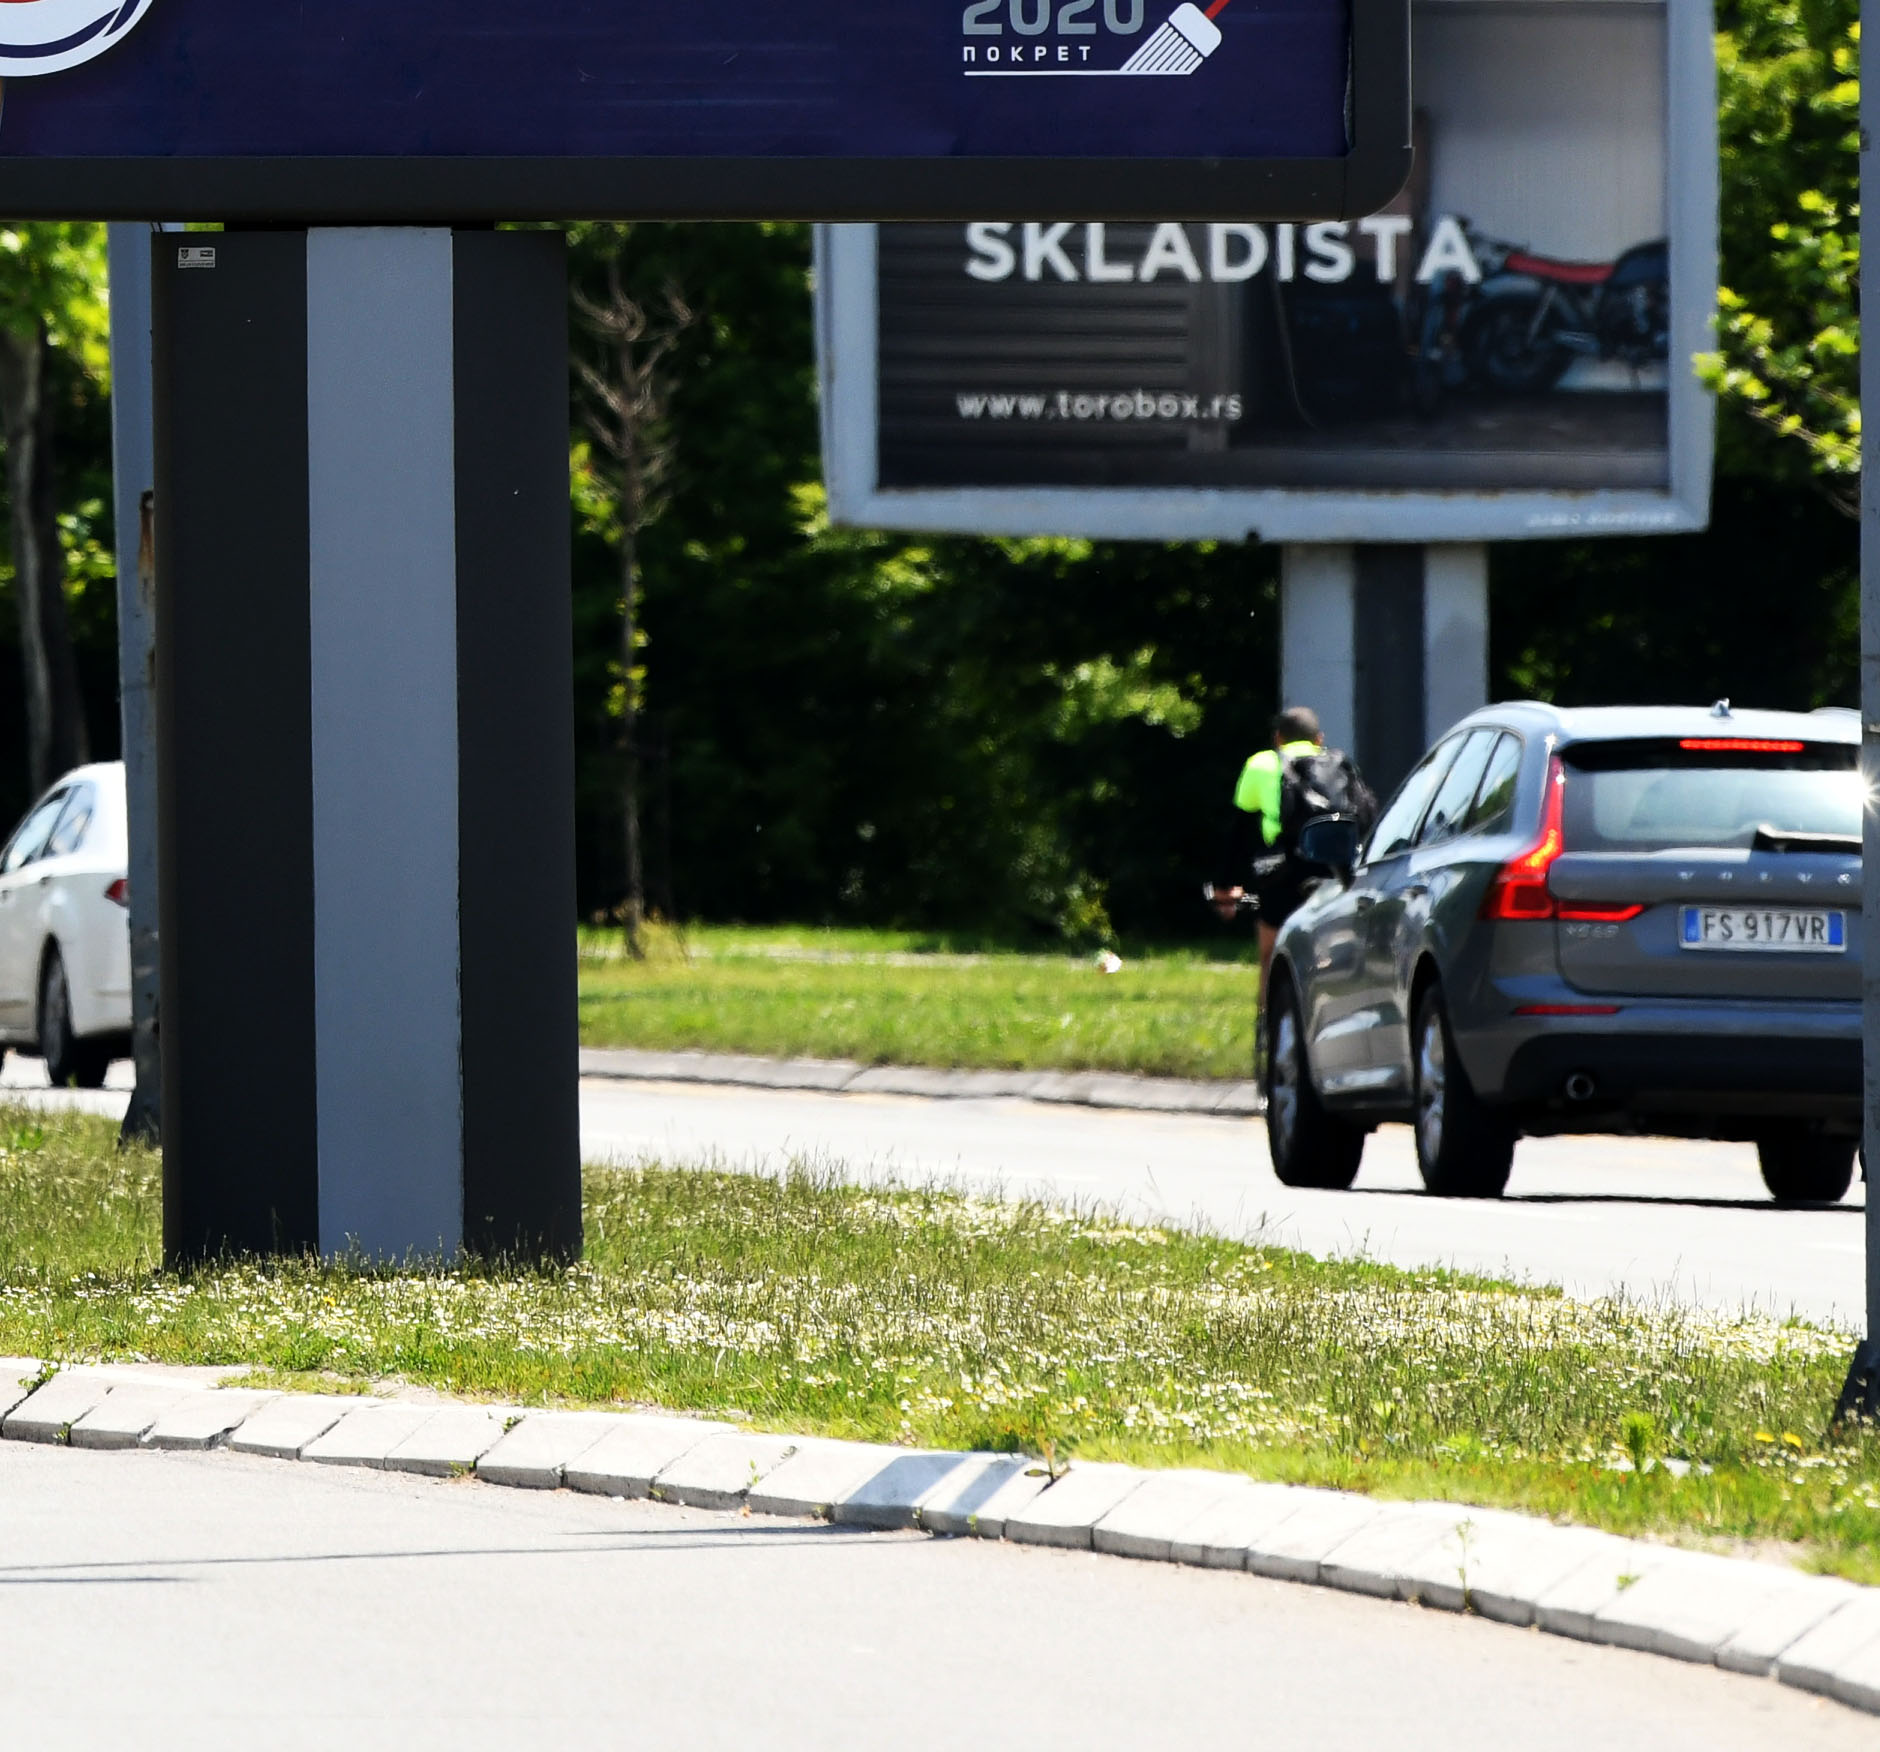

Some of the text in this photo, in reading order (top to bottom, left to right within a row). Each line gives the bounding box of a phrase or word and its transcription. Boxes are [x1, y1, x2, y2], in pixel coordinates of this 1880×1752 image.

[963, 46, 1091, 62] ПОКРЕТ
[956, 388, 1242, 422] www.torobox.rs
[1703, 914, 1826, 942] FS 917VR
